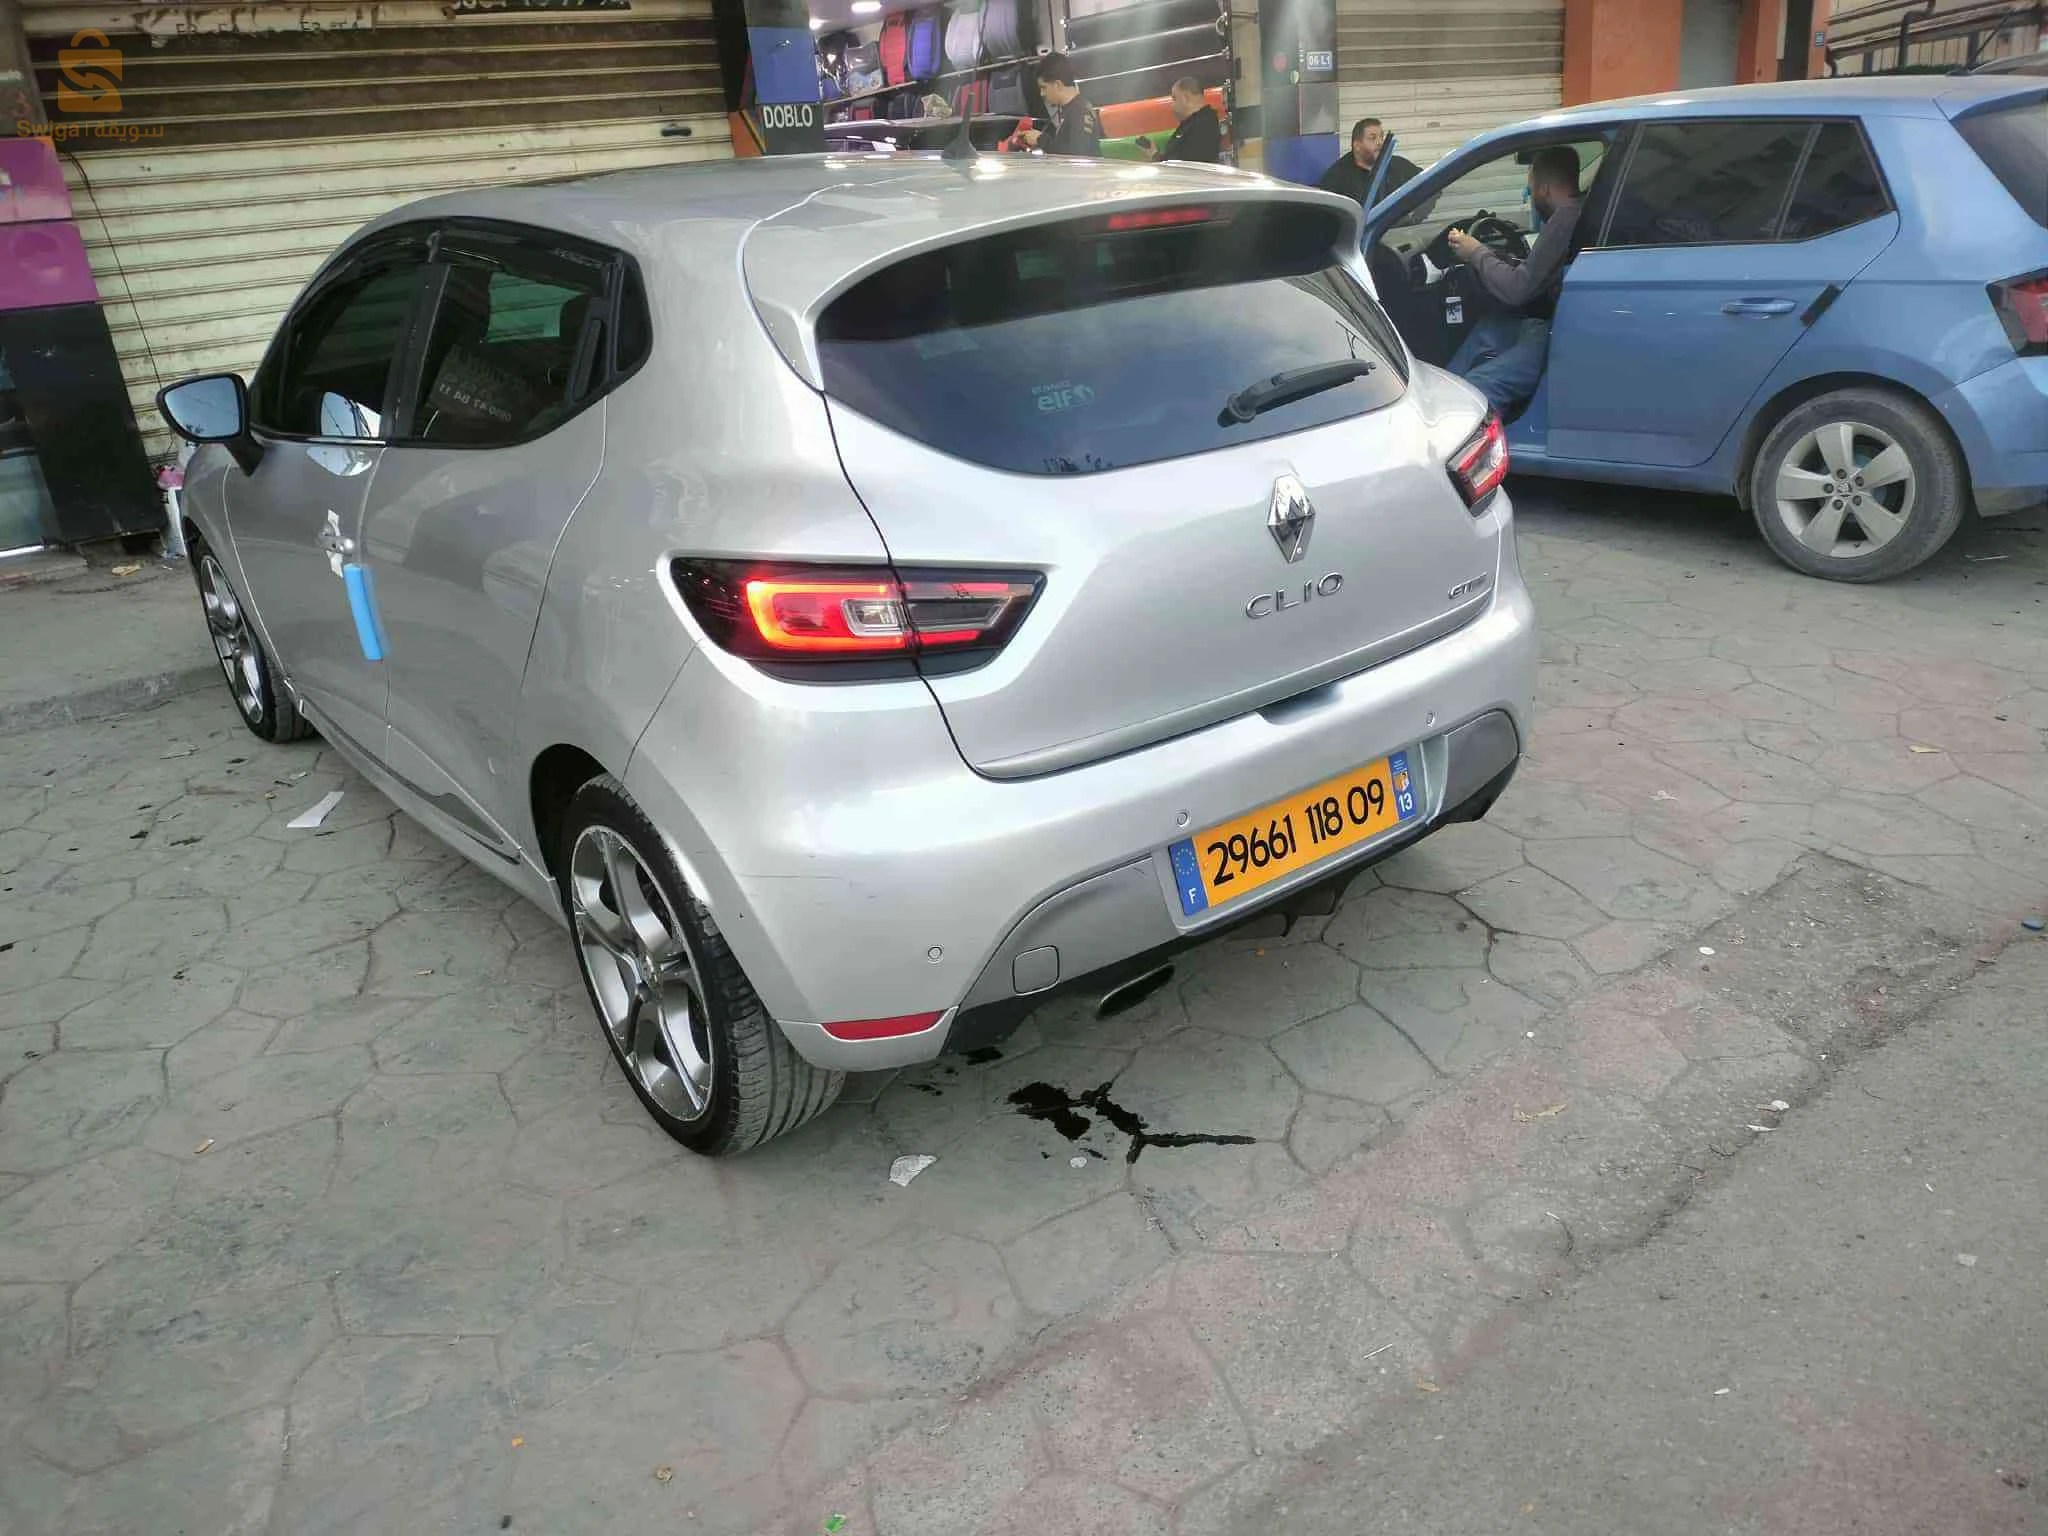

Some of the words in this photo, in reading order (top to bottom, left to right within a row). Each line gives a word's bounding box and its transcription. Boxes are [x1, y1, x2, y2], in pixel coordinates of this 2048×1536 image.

[763, 104, 813, 128] DOBLO
[1246, 571, 1343, 620] CLIO
[1399, 792, 1413, 812] 13
[1207, 814, 1297, 887] 29661
[1305, 796, 1343, 844] 118
[1347, 778, 1385, 825] 09
[1188, 887, 1198, 904] F
